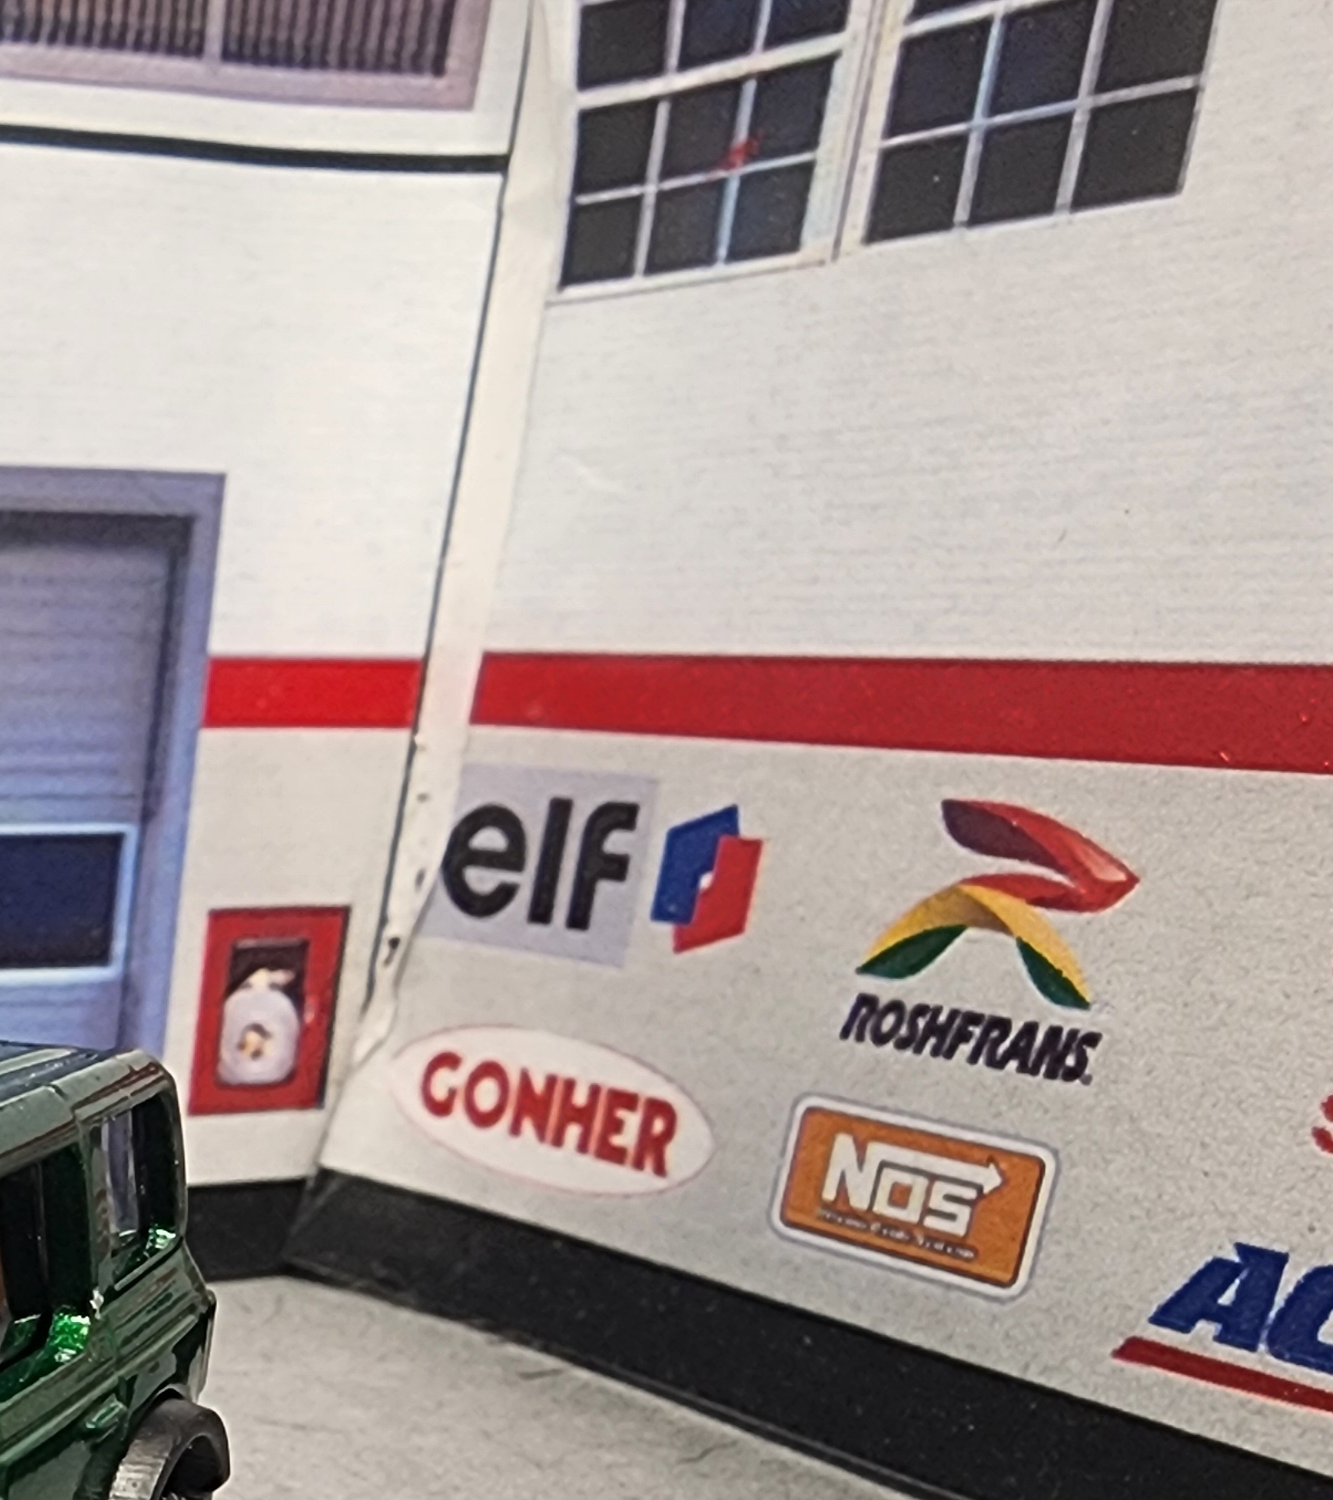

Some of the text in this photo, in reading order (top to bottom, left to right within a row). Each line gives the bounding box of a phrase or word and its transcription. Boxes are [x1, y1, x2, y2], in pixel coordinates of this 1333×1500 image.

[441, 797, 640, 931] elf
[838, 993, 1103, 1083] ROSHFRANS
[421, 1051, 677, 1178] GONHER
[821, 1132, 1001, 1237] NOS
